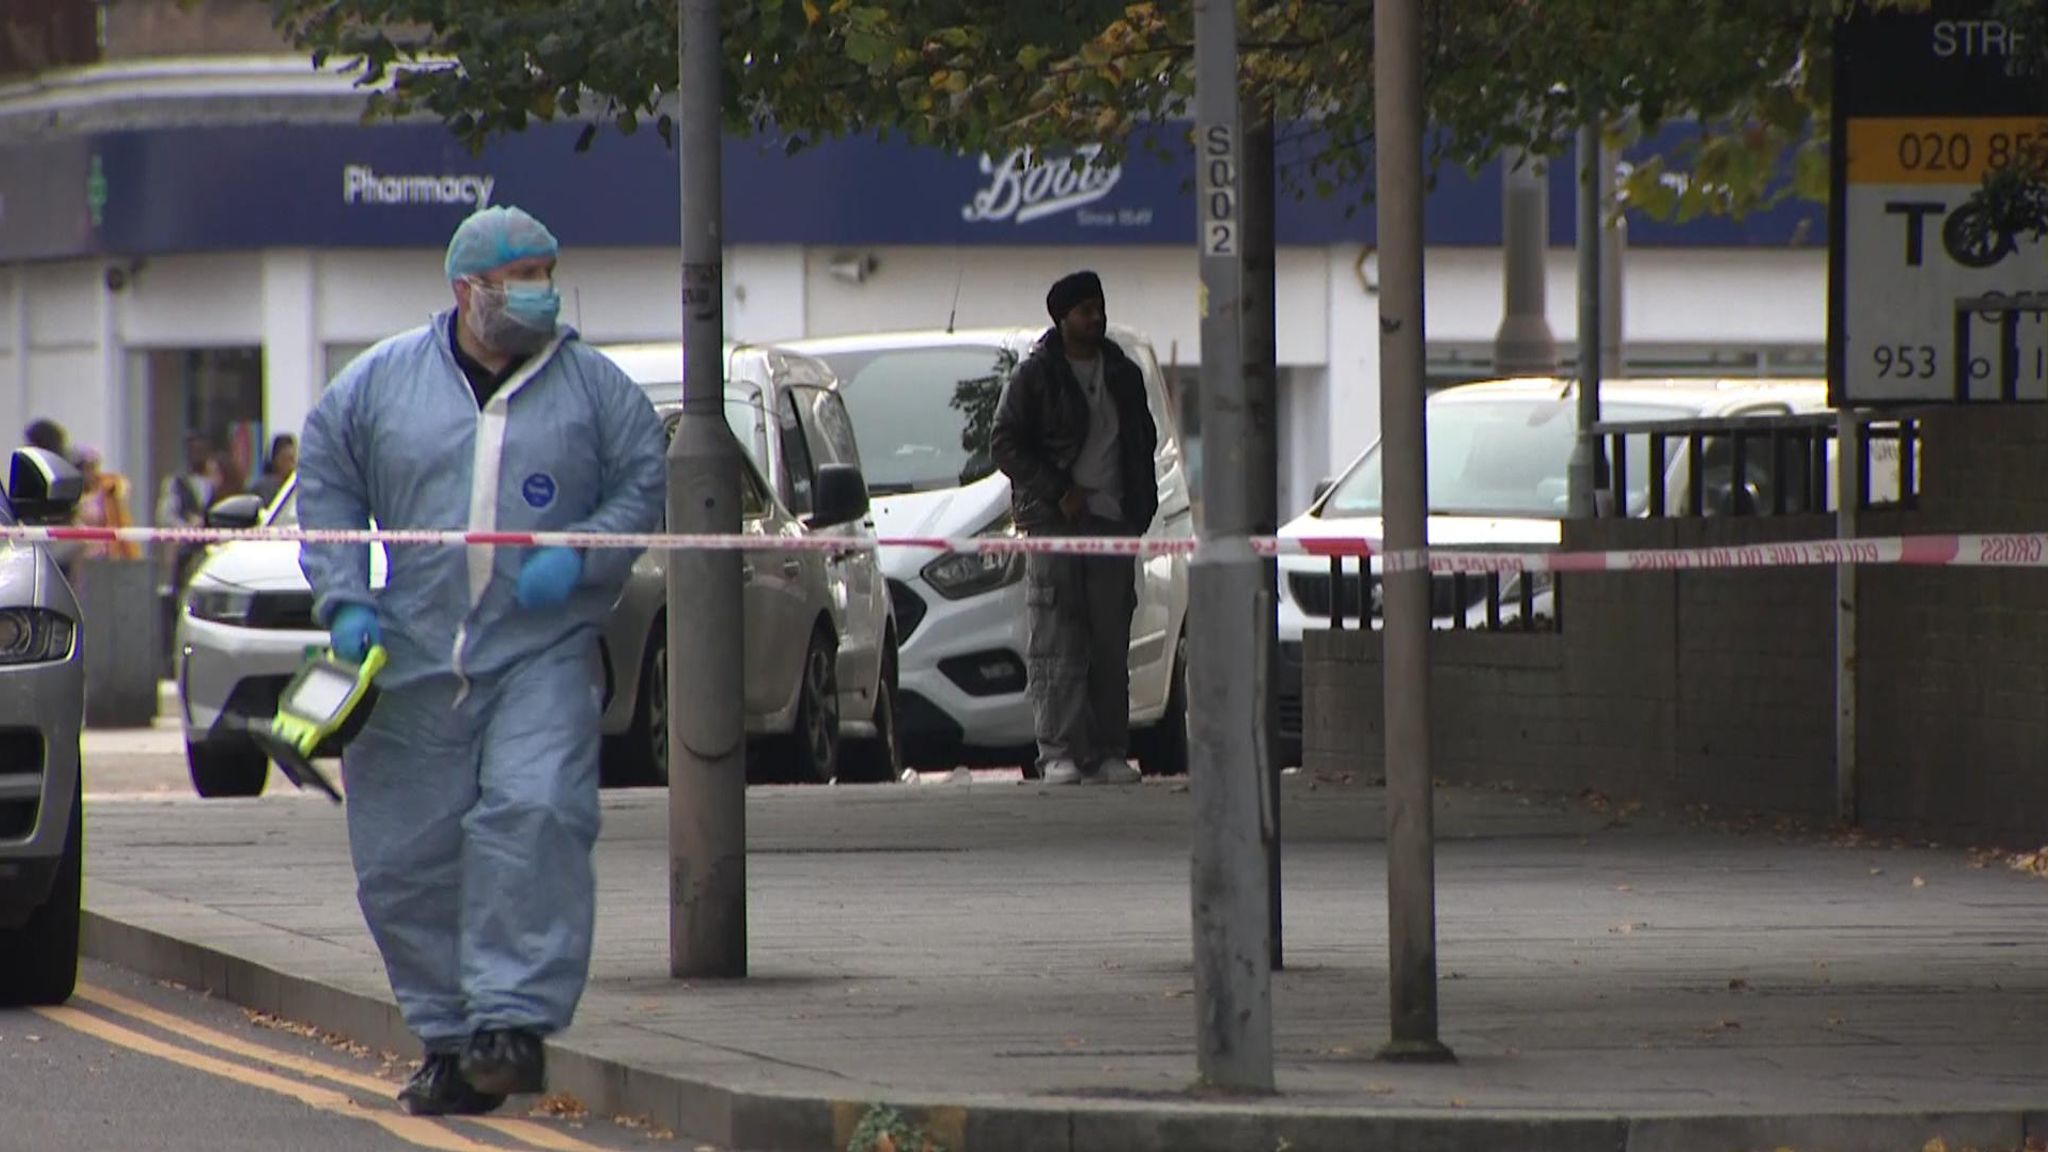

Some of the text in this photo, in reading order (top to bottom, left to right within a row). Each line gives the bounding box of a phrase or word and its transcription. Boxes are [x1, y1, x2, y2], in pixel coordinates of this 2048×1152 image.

[1899, 132, 1971, 171] 020
[343, 164, 495, 211] Pharmacy
[1873, 345, 1937, 379] 953
